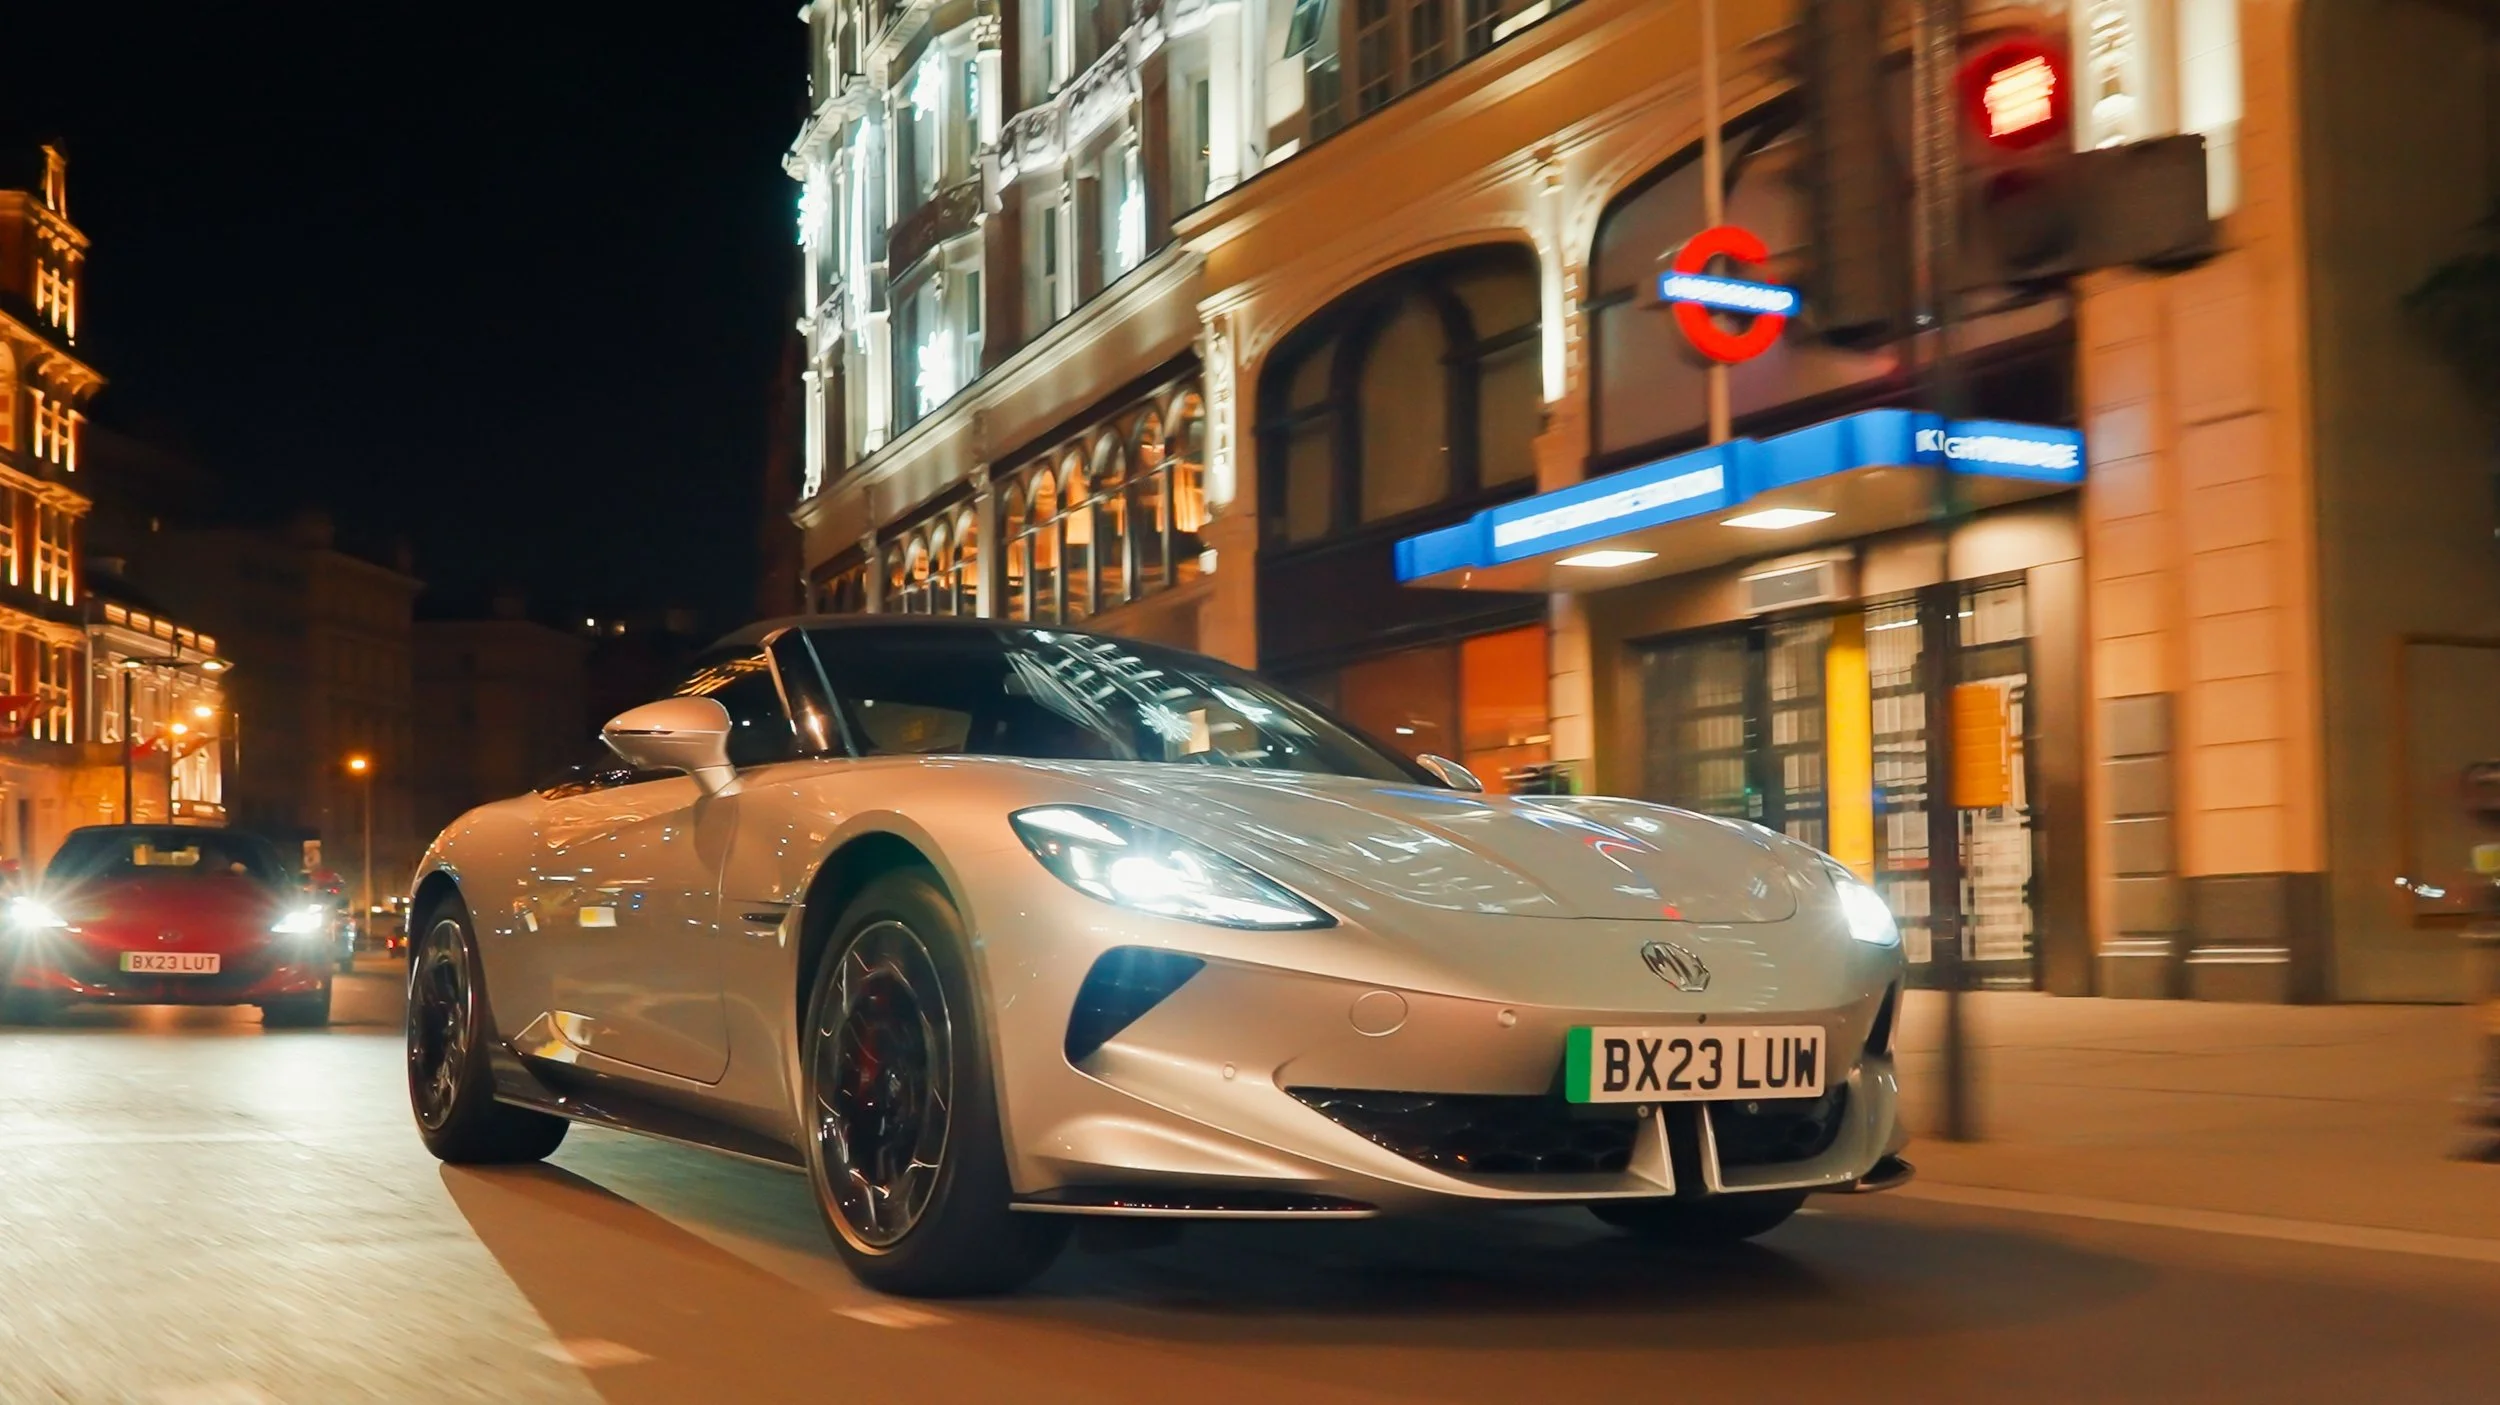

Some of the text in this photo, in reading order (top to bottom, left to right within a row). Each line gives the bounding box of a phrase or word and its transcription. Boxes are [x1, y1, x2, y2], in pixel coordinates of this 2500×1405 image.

[132, 955, 217, 971] BX23 LUT
[1602, 1037, 1818, 1092] BX23 LUW
